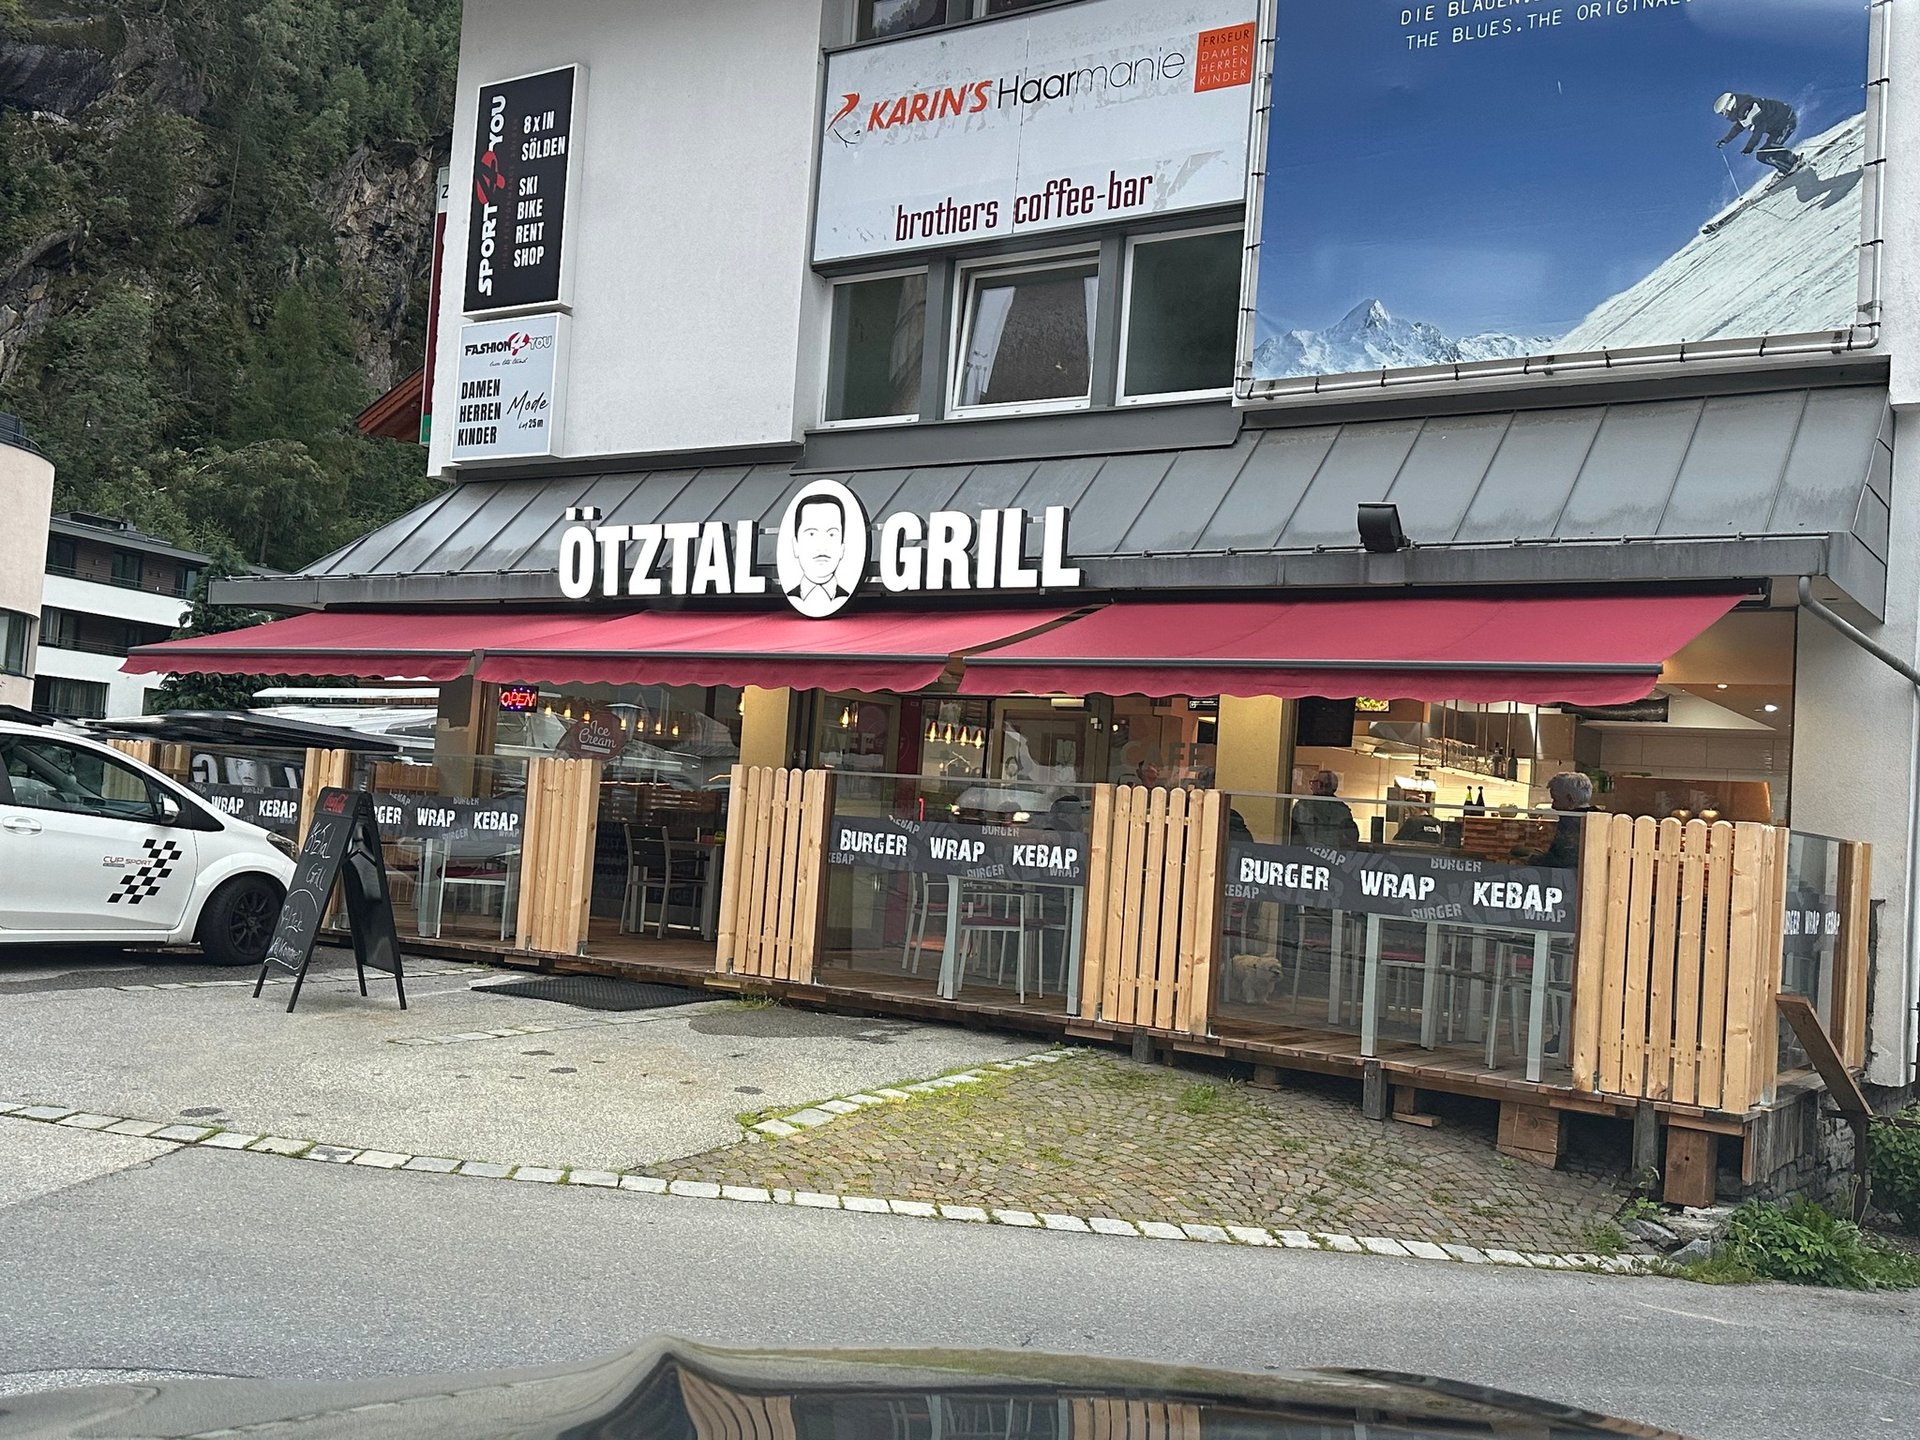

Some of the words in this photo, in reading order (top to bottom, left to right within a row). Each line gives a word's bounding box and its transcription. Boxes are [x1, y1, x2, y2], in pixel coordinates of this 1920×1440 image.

[1400, 5, 1435, 26] DIE
[1203, 29, 1250, 47] FRISEUR
[1405, 30, 1439, 50] THE
[1202, 43, 1249, 62] DAMEN
[1201, 57, 1248, 73] HERREN
[1200, 69, 1246, 86] KINDER
[867, 79, 994, 133] KARIN'S
[997, 47, 1186, 110] Haarmanie
[521, 136, 566, 161] SÖLDEN
[519, 175, 538, 197] SKI
[517, 198, 544, 220] BIKE
[896, 197, 998, 242] brothers
[1014, 170, 1153, 225] coffee-bar
[515, 221, 545, 244] RENT
[513, 245, 545, 268] SHOP
[461, 378, 501, 400] DAMEN
[459, 402, 502, 423] HERREN
[506, 390, 549, 420] Mode
[457, 426, 497, 446] KINDER
[558, 506, 767, 599] ÖTZTAL
[880, 505, 1082, 592] GRILL
[501, 691, 535, 707] OPEN
[579, 727, 617, 748] Cream
[590, 720, 610, 737] Ice
[259, 799, 298, 818] KEBAP
[416, 807, 456, 828] WRAP
[473, 811, 519, 831] KEBAP
[840, 828, 908, 856] BURGER
[930, 836, 985, 862] WRAP
[1012, 844, 1078, 869] KEBAP
[103, 856, 125, 864] CUP
[1240, 857, 1330, 891] BURGER
[1360, 869, 1435, 901] WRAP
[1473, 881, 1563, 912] KEBAP
